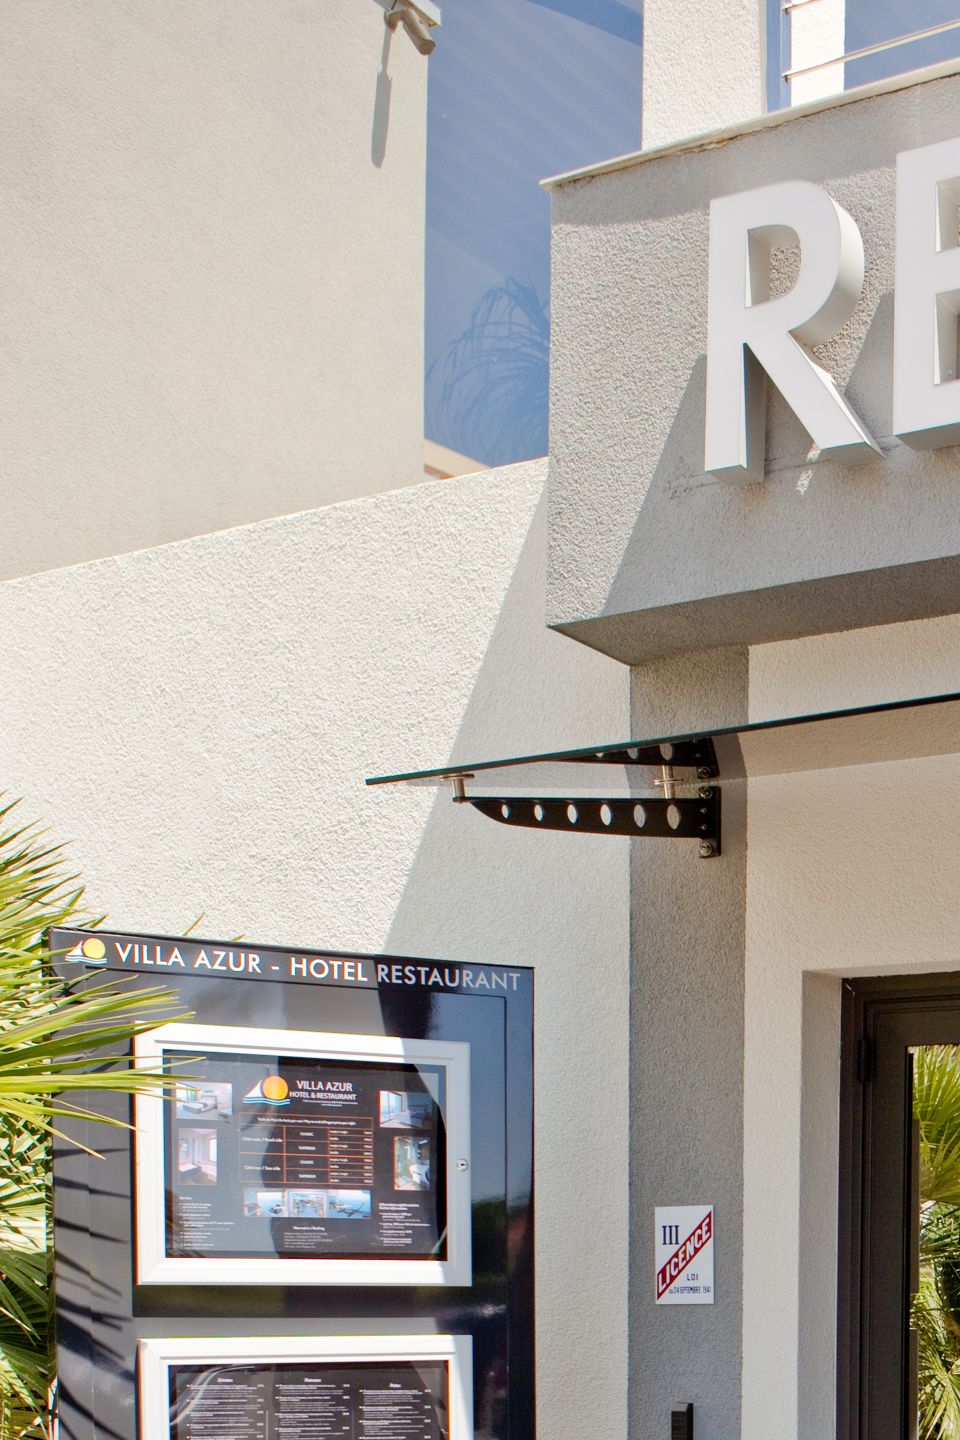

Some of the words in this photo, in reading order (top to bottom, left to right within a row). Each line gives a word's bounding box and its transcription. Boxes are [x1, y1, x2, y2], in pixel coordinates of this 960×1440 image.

[114, 942, 186, 968] VILLA
[193, 950, 262, 974] AZUR
[290, 957, 369, 983] HOTEL
[377, 963, 521, 992] RESTAURANT
[296, 1080, 325, 1091] VILLA
[327, 1082, 353, 1092] AZUR
[289, 1091, 310, 1099] HOTEL
[316, 1093, 357, 1101] RESTAURANT
[662, 1225, 680, 1246] III
[658, 1217, 711, 1294] LICENCE
[686, 1273, 699, 1281] LOI
